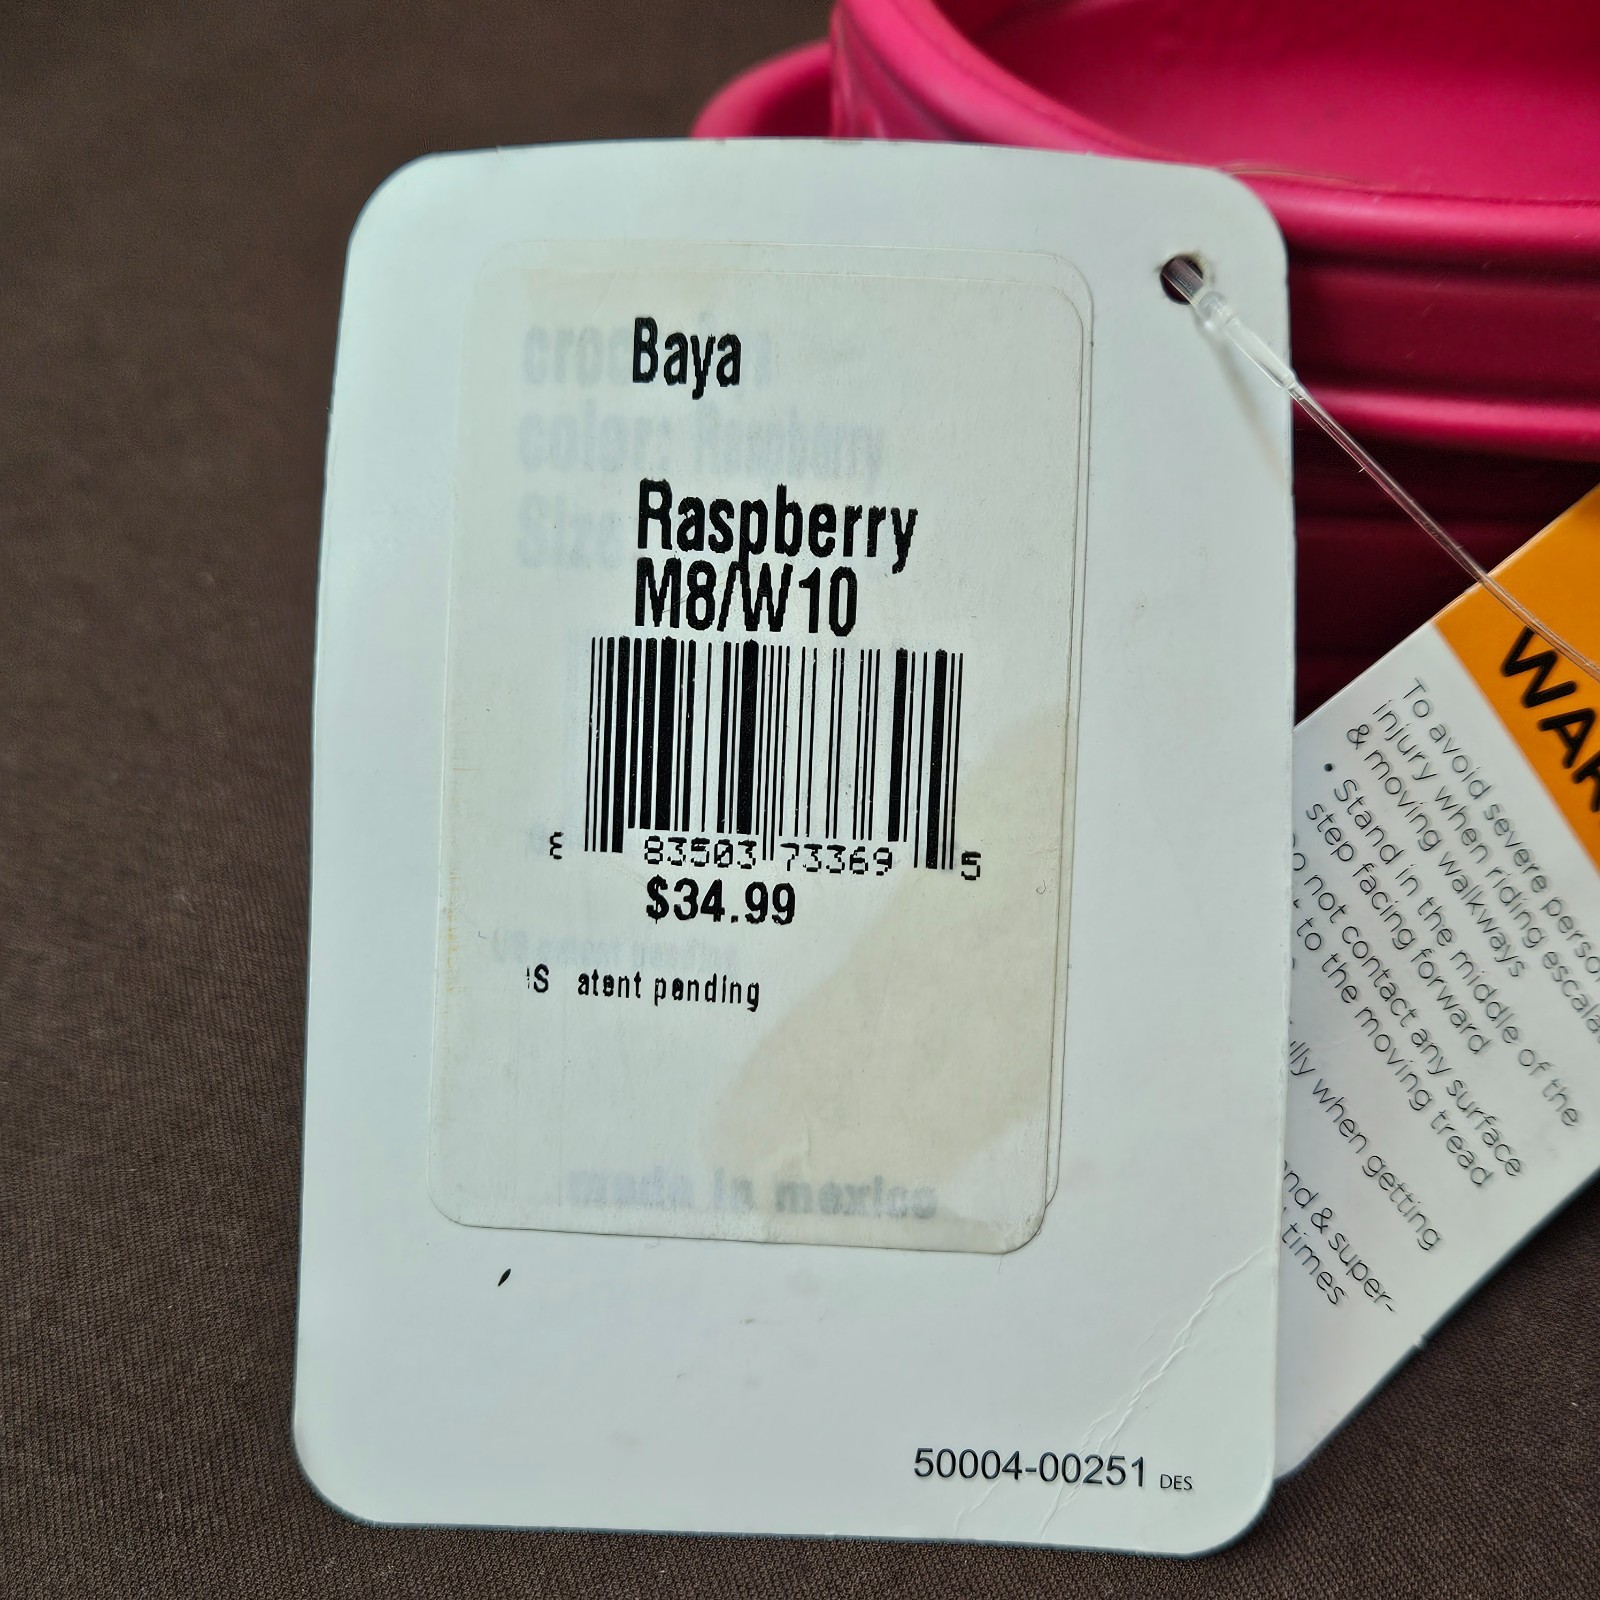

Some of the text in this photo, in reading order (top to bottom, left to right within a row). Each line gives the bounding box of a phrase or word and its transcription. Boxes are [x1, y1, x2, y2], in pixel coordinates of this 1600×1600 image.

[632, 316, 742, 400] Baya
[637, 477, 919, 575] Raspberry
[635, 557, 859, 637] M8/W10
[644, 835, 757, 869] 83503
[780, 842, 893, 876] 73369
[960, 851, 982, 881] 5
[1347, 724, 1525, 978] & moving walkways
[1373, 699, 1600, 1045] injury when riding escala
[1403, 677, 1600, 983] To avoid severe perso
[646, 873, 797, 925] $34.99
[1306, 803, 1492, 1055] step facing forward
[654, 972, 760, 1012] pending
[1334, 779, 1578, 1127] Stand in the middle of the
[1296, 917, 1495, 1187] to the moving tread
[1303, 874, 1347, 924] not
[1342, 926, 1417, 1028] contact
[1411, 1028, 1452, 1075] any
[1446, 1079, 1521, 1176] surface
[1312, 1078, 1367, 1154] when
[1362, 1155, 1442, 1251] getting
[1281, 1222, 1346, 1305] times
[1311, 1207, 1333, 1234] &
[1328, 1232, 1395, 1312] super-
[913, 1447, 1193, 1491] 50004-00251 DES
